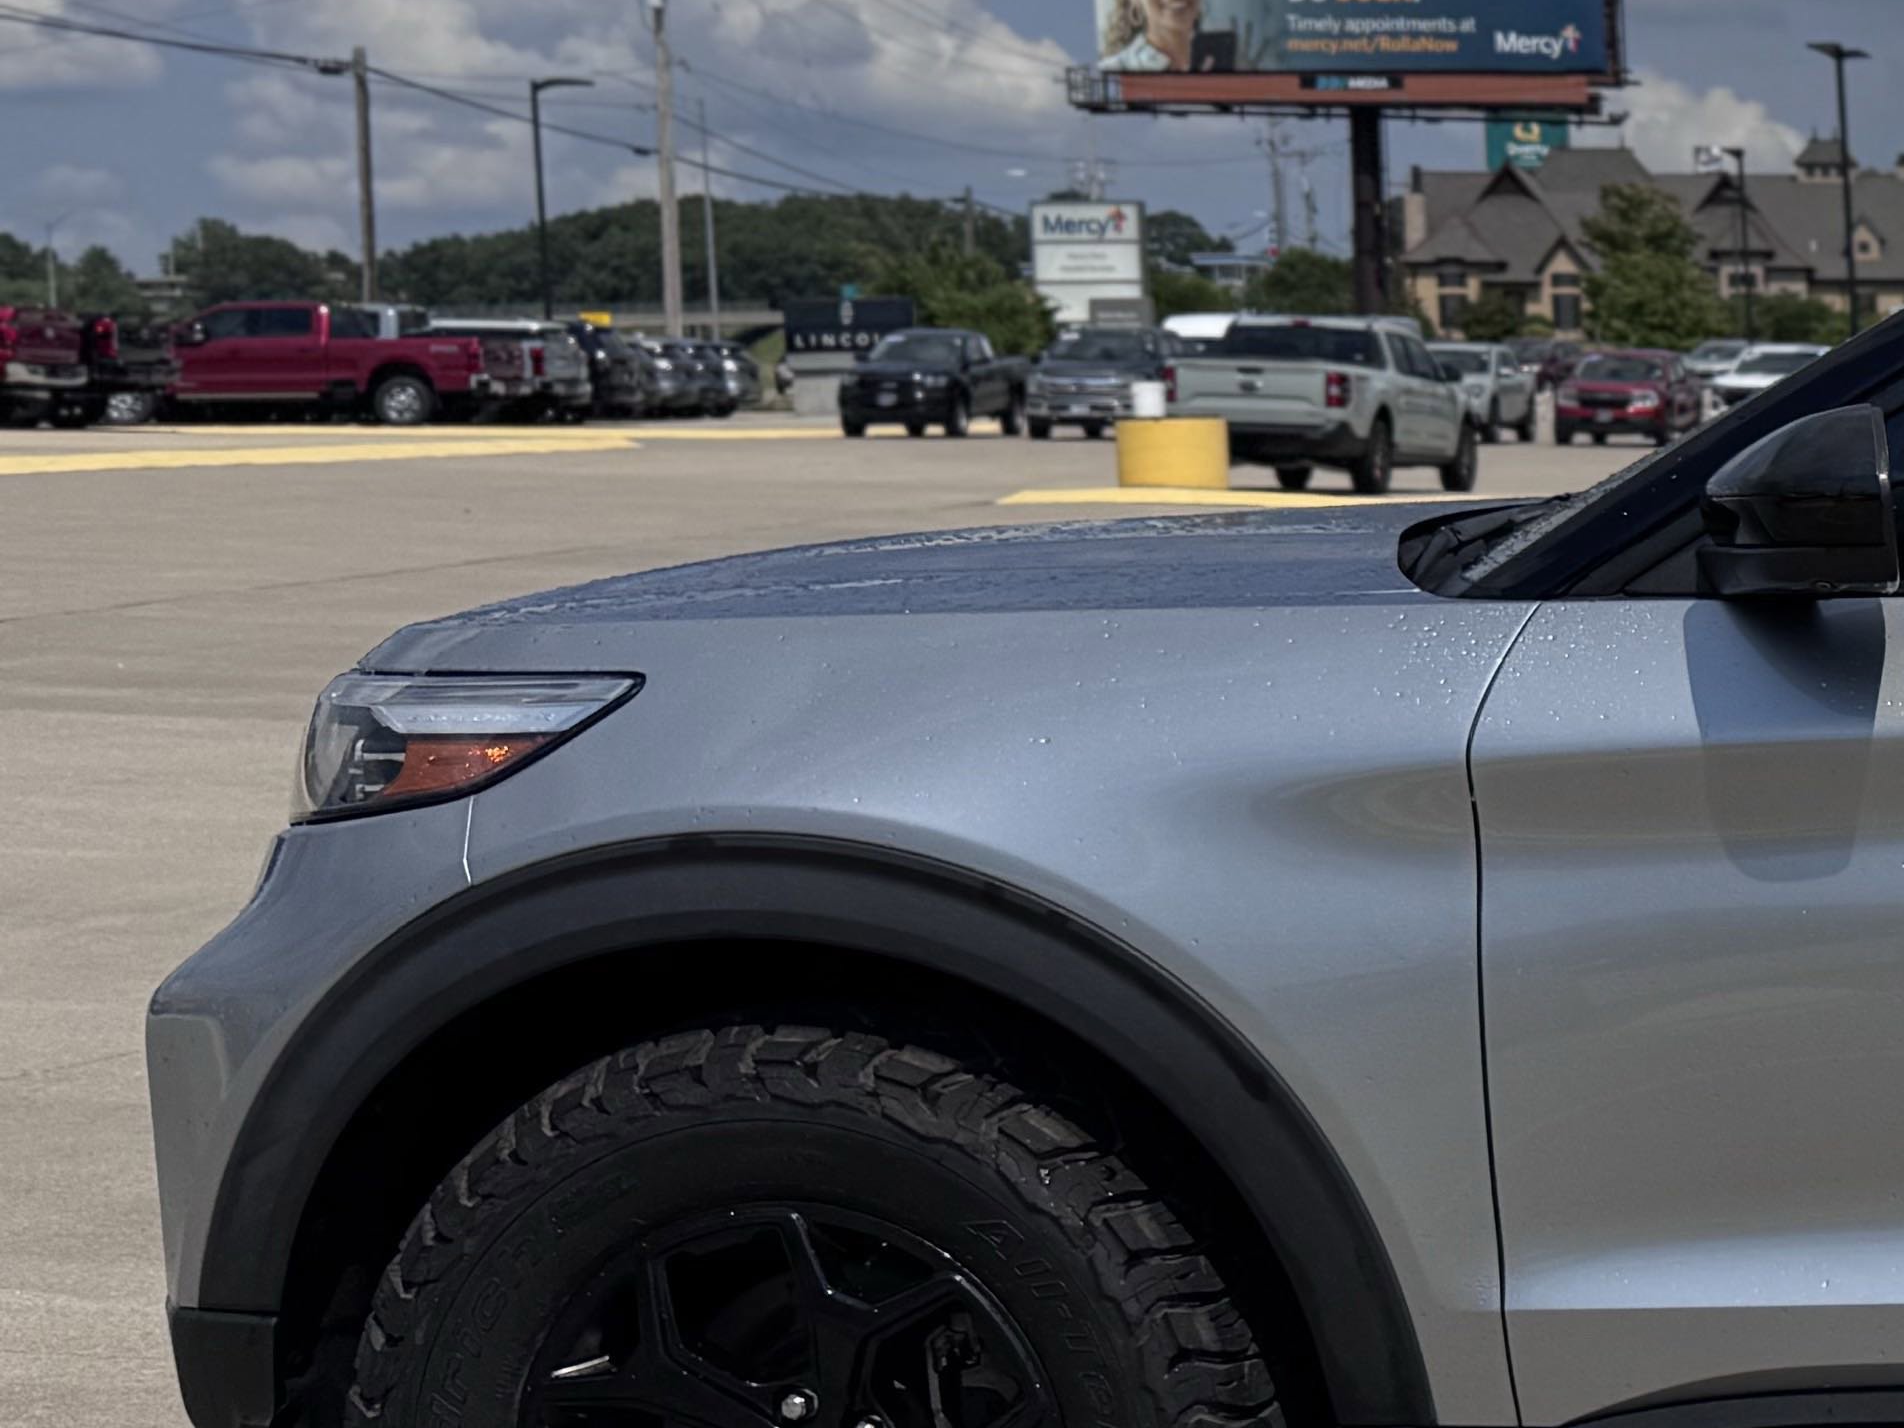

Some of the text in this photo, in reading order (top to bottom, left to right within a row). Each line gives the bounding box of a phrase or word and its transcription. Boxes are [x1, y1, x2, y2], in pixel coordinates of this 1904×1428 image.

[1287, 15, 1476, 36] Timely appointments at
[1495, 31, 1564, 59] Mercy
[1042, 213, 1109, 240] Mercy
[793, 331, 881, 349] LINCO
